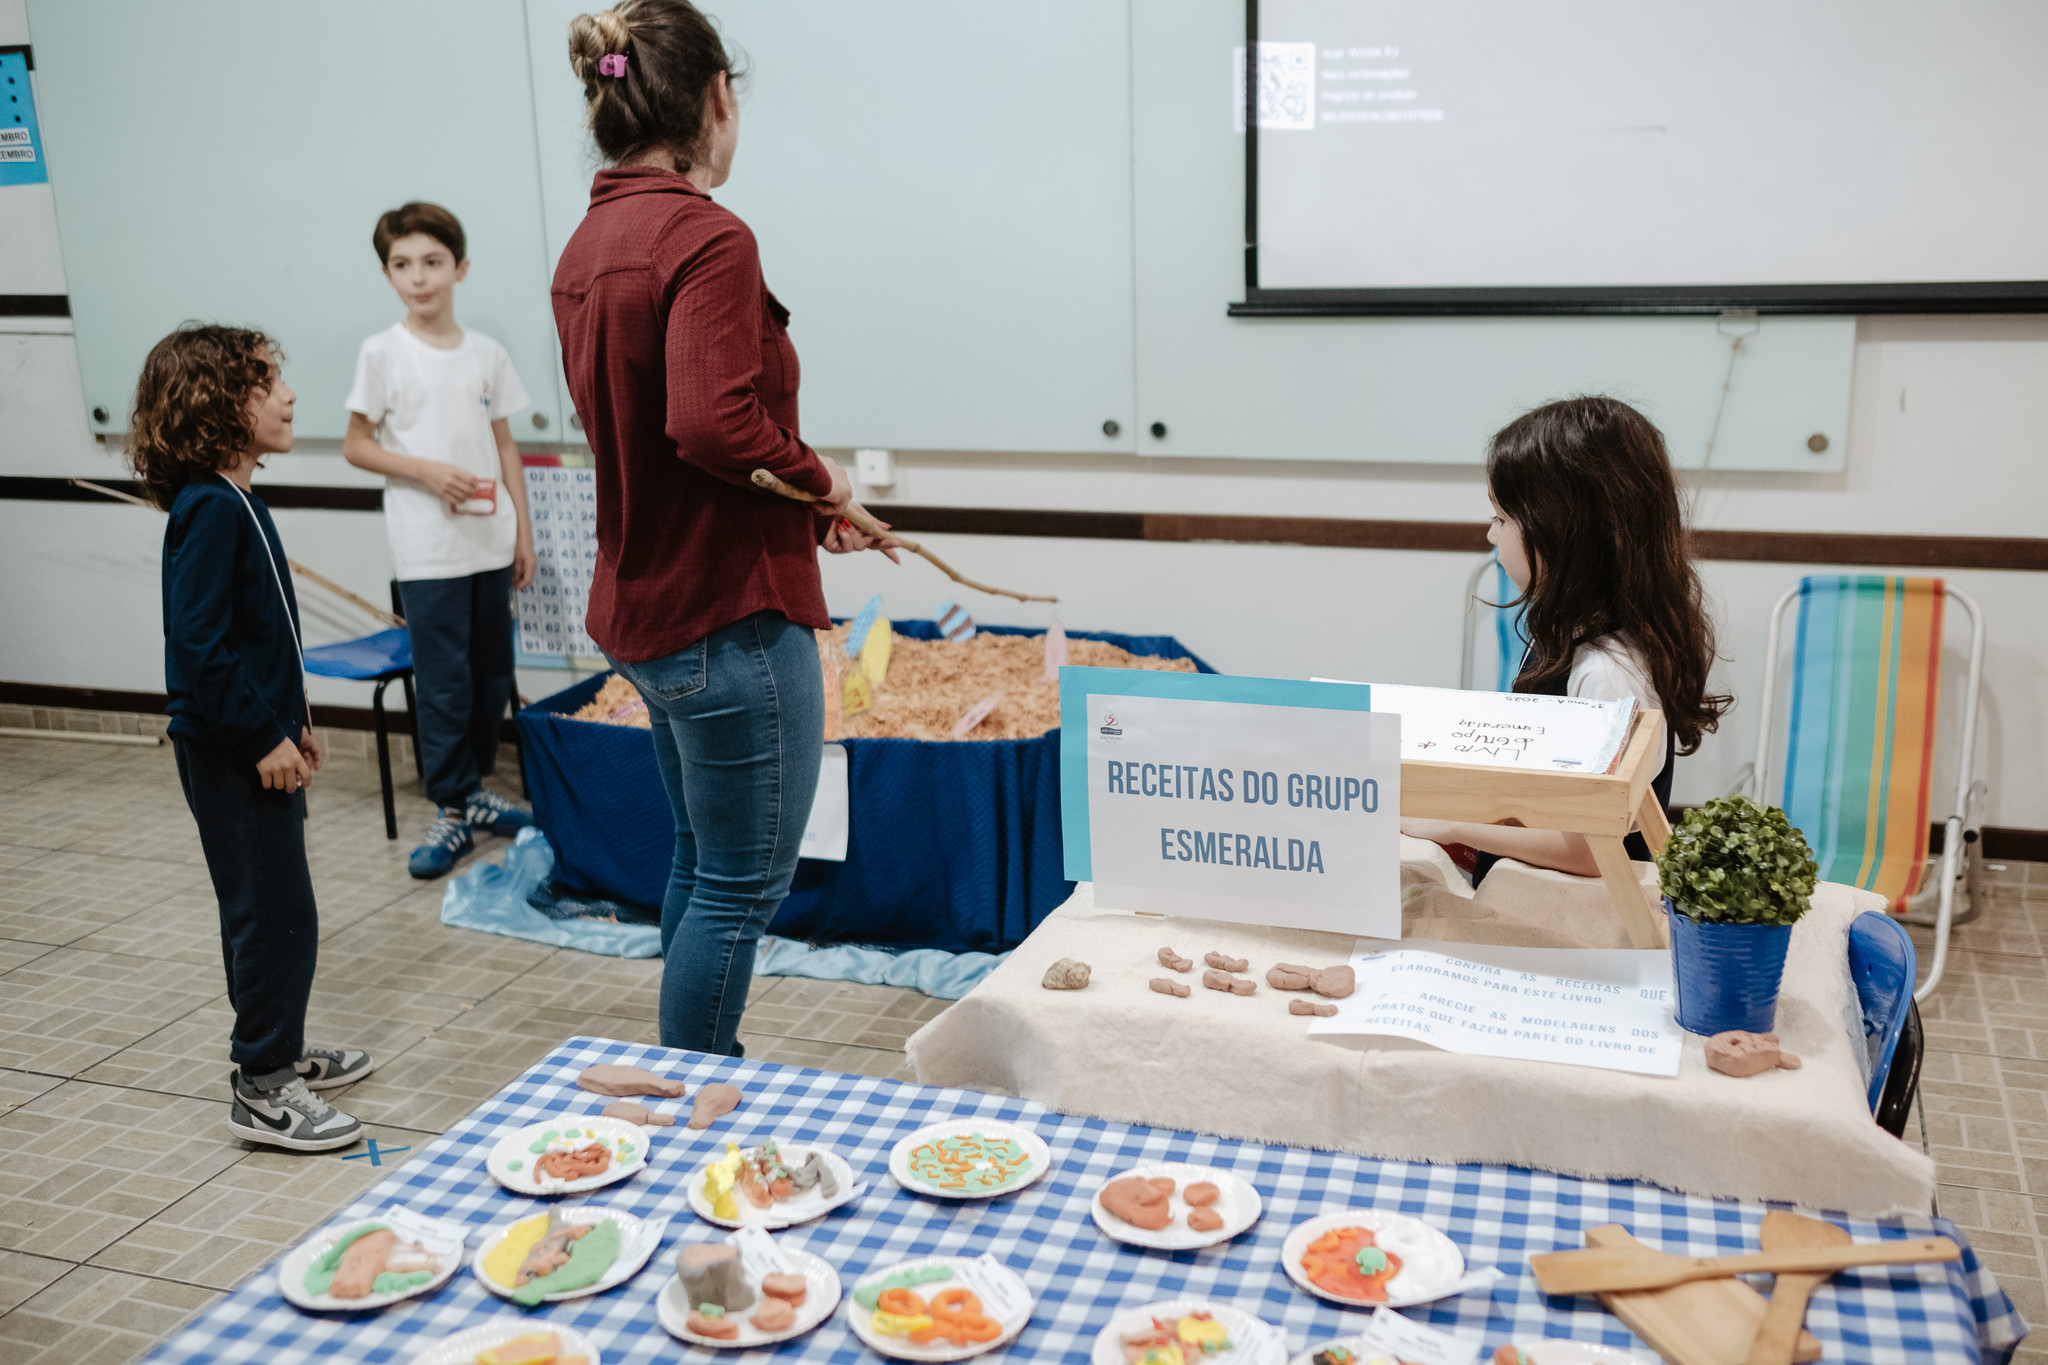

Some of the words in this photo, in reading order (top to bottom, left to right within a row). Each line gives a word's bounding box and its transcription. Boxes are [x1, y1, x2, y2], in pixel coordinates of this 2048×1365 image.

[0, 131, 28, 142] MBRO
[1454, 745, 1520, 761] Livro
[1108, 760, 1234, 802] RECEITAS
[1243, 770, 1278, 806] DO
[1288, 773, 1378, 813] GRUPO
[1160, 827, 1325, 874] ESMERALDA
[1391, 963, 1479, 985] ELABORAMOS
[1483, 980, 1518, 993] PARA
[1523, 987, 1558, 999] ESTE
[1562, 992, 1606, 1005] LIVRO.
[1445, 957, 1501, 976] CONFIRA
[1519, 972, 1537, 982] AS
[1555, 978, 1622, 995] RECEITAS
[1640, 988, 1667, 1001] QUE
[1372, 1003, 1425, 1015] PRATOS
[1429, 1010, 1456, 1025] QUE
[1460, 1019, 1508, 1036] FAZEM
[1513, 1030, 1559, 1043] PARTE
[1565, 1036, 1584, 1046] DO
[1589, 1039, 1632, 1052] LIVRO
[1638, 1045, 1657, 1055] DE
[1419, 992, 1477, 1014] APRECIE
[1489, 1011, 1508, 1021] AS
[1521, 1016, 1616, 1034] MODELAGENS
[1631, 1028, 1659, 1039] DOS
